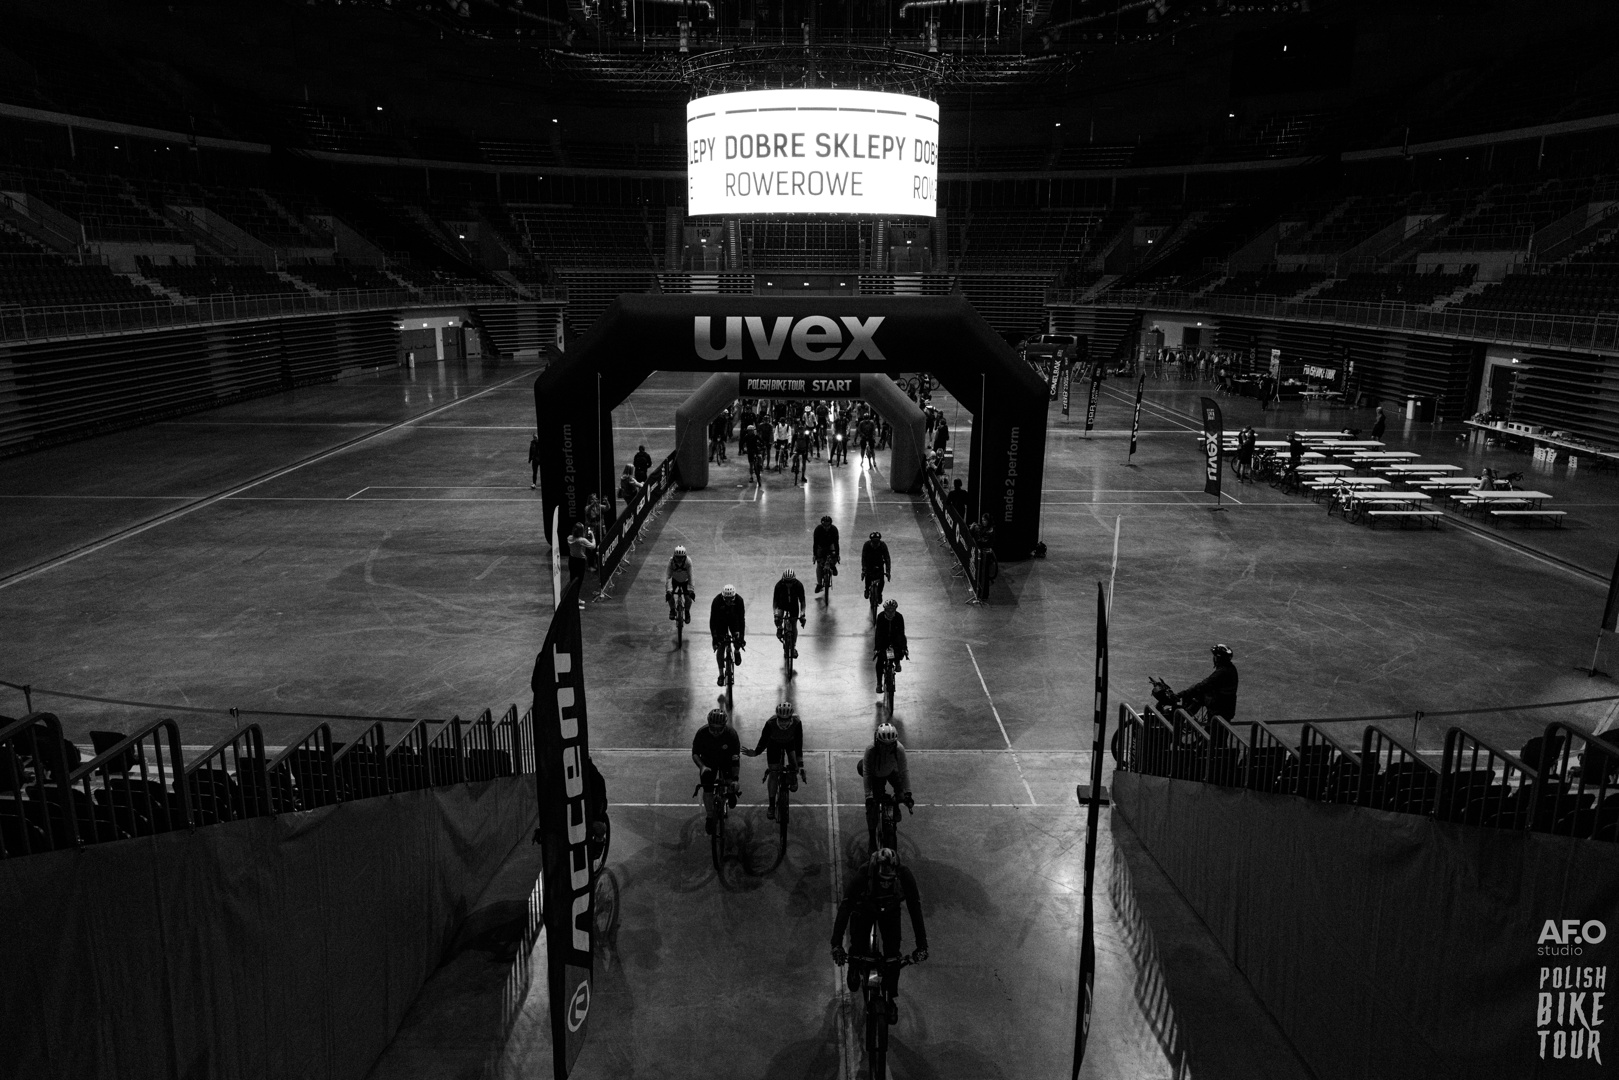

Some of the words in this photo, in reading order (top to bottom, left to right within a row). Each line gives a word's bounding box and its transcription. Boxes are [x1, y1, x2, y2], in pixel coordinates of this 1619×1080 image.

[725, 133, 805, 159] DOBRE
[815, 133, 906, 160] SKLEPY
[725, 171, 863, 197] ROWEROWE
[697, 229, 711, 238] 1-05
[903, 230, 917, 239] 1-06
[694, 315, 886, 362] uvex
[771, 379, 788, 392] BIKE
[788, 379, 806, 392] TOUR
[812, 380, 852, 392] START
[562, 424, 576, 473] perform
[1007, 426, 1020, 477] perform
[564, 475, 574, 483] 2
[1004, 478, 1016, 487] 2
[564, 485, 576, 518] made
[1004, 488, 1014, 522] made
